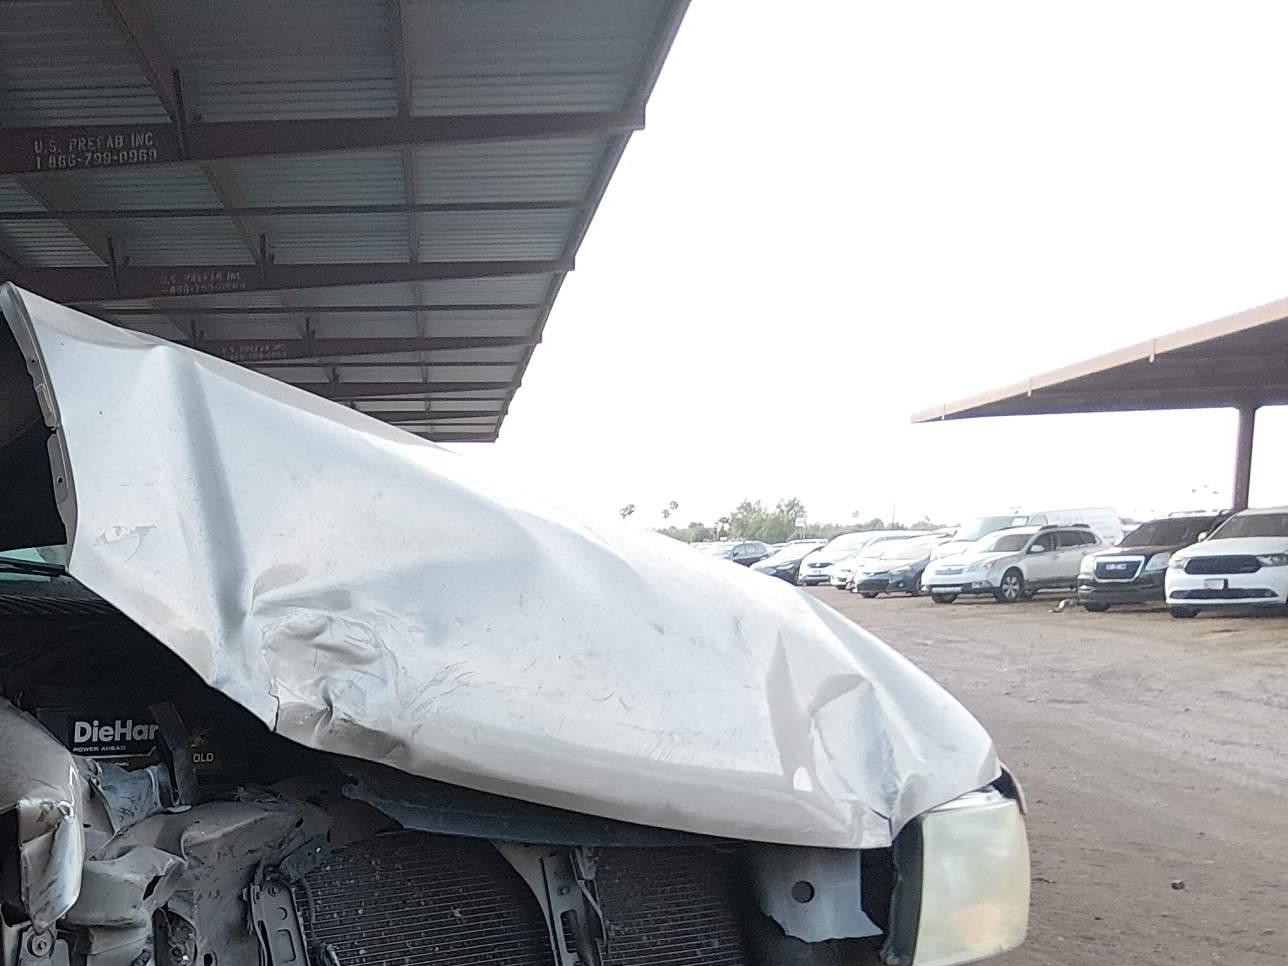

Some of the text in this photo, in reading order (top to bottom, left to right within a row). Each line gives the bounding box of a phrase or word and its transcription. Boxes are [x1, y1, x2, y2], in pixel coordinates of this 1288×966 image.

[69, 134, 124, 152] PREFAB
[74, 720, 160, 743] DieHar
[192, 752, 214, 763] OLD
